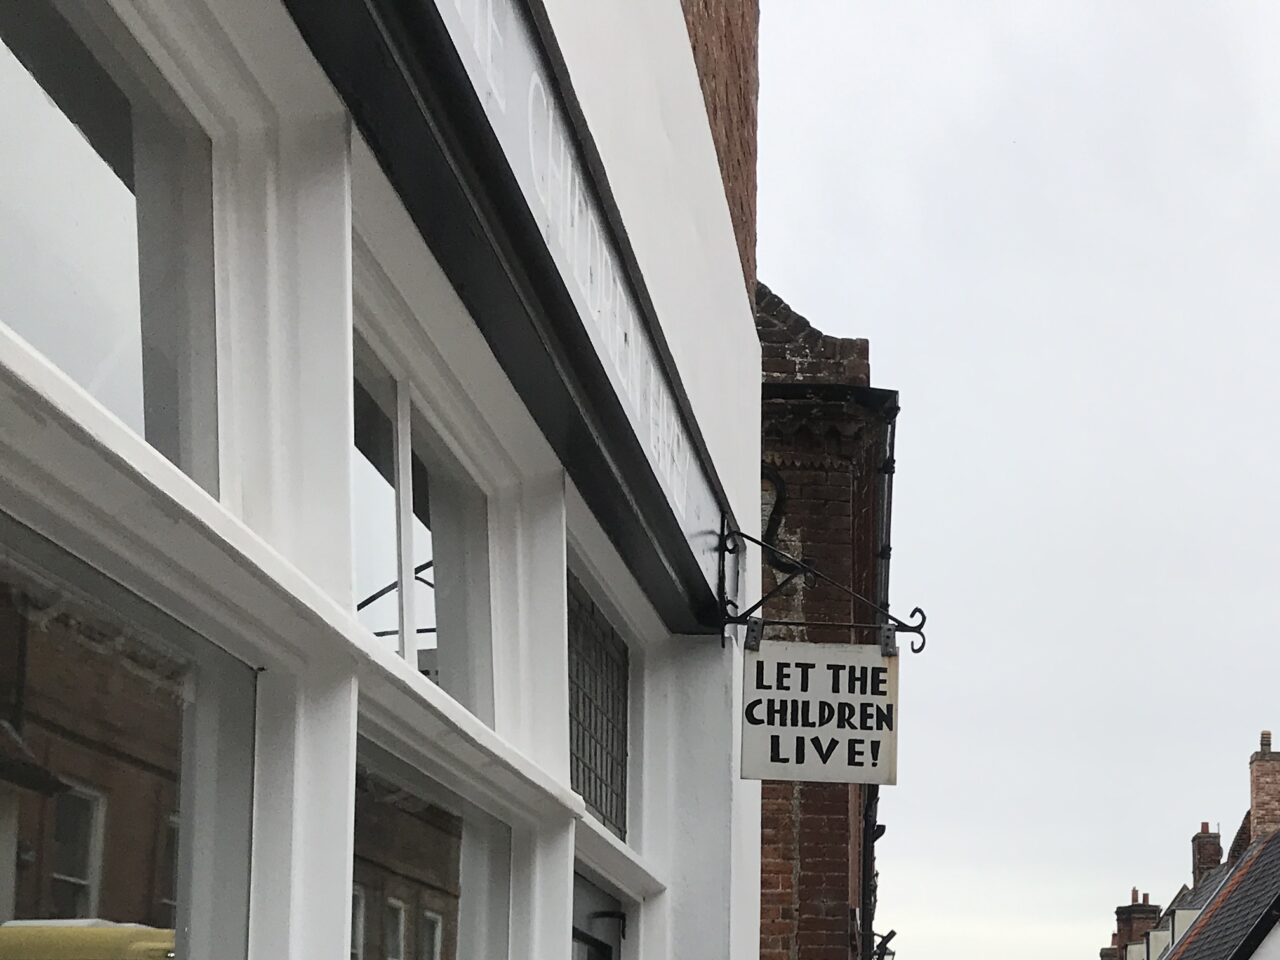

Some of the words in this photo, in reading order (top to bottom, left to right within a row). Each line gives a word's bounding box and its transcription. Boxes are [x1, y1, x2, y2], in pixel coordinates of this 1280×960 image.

[755, 660, 815, 692] LET
[826, 664, 888, 696] THE
[744, 699, 894, 731] CHILDREN
[770, 735, 881, 767] LIVE!
